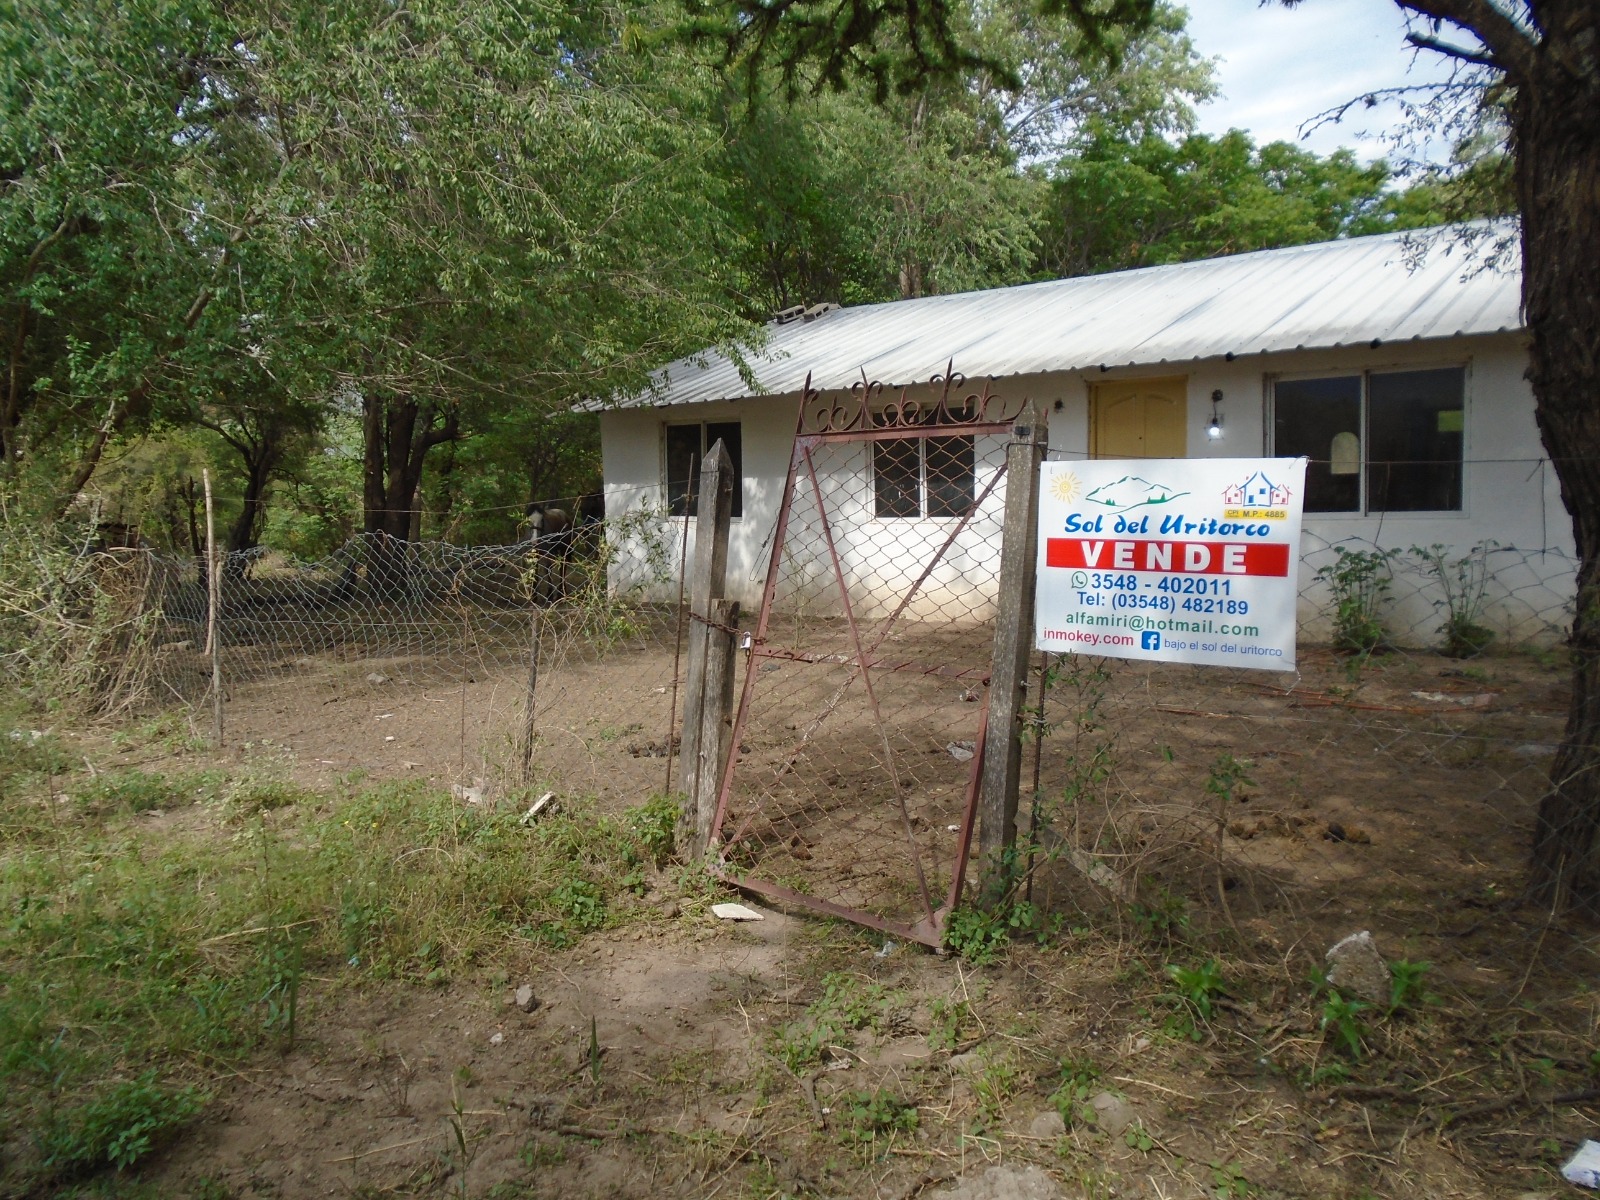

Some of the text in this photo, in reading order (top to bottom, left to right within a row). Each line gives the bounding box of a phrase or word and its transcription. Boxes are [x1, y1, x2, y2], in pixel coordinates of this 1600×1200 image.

[1064, 513, 1270, 537] Sol del Uritorco
[1264, 510, 1285, 518] 4885
[1081, 541, 1247, 573] VENDE
[1091, 573, 1137, 591] 3548
[1157, 576, 1231, 596] 402011
[1077, 591, 1249, 615] Tel: (03548) 482189
[1066, 612, 1260, 637] alfamiri@hotmail.com
[1043, 627, 1134, 646] inmokey.com
[1164, 638, 1283, 657] bajo el sol del uritorco
